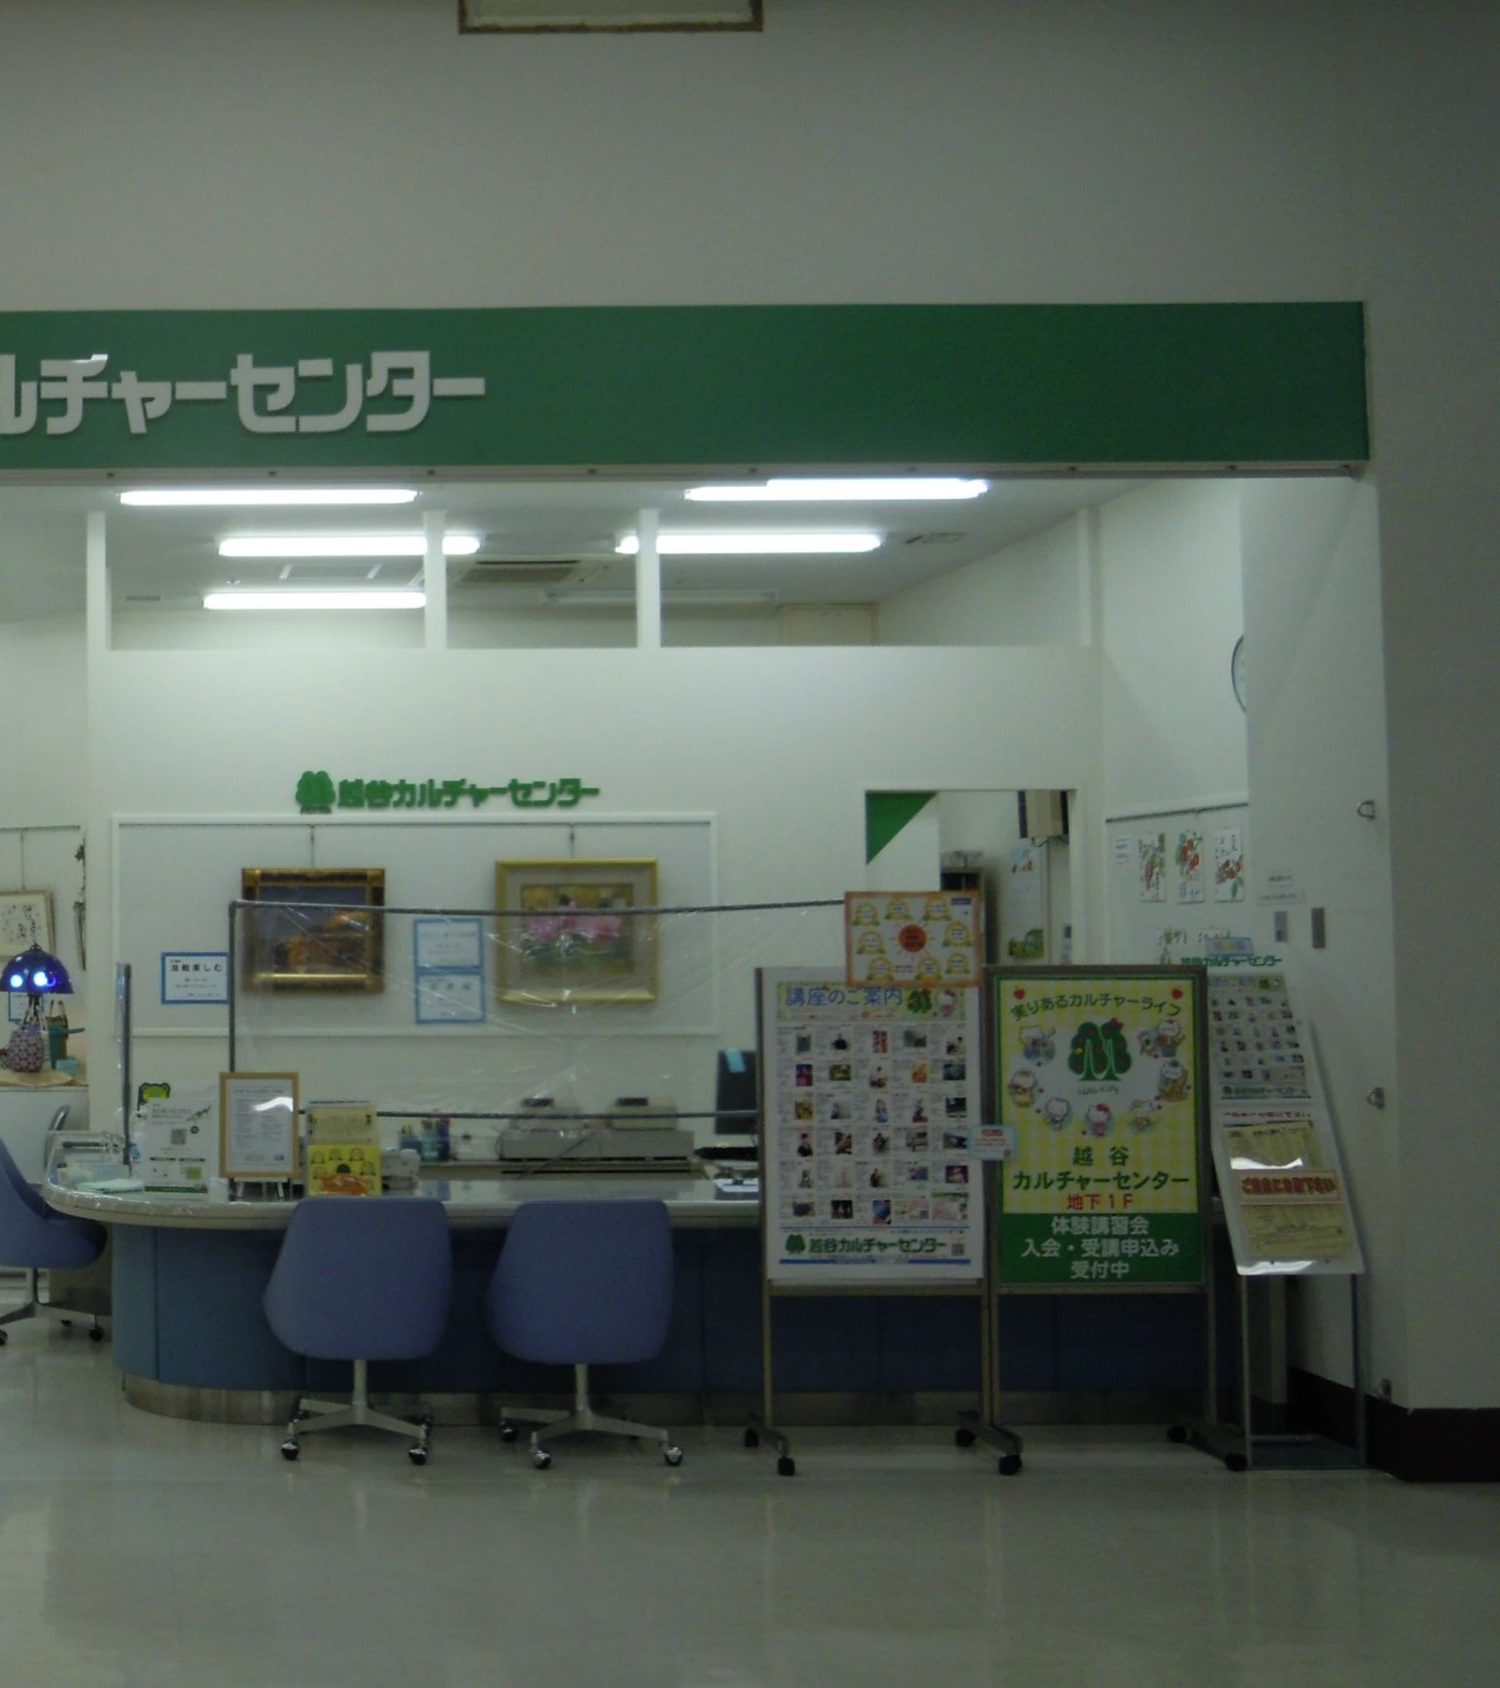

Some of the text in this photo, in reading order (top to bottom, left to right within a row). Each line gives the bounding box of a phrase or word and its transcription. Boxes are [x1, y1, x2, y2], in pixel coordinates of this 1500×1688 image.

[338, 778, 600, 808] 越谷カルチャーセンター
[786, 985, 903, 1007] 講座のご案内
[1010, 992, 1182, 1021] 実りあるカルチャーライフ
[1072, 1145, 1129, 1166] 越谷
[1013, 1171, 1190, 1190] カルチャーセンター
[1051, 1216, 1149, 1235] 体験講習会
[809, 1237, 947, 1253] 越谷カルチャーセンター
[1021, 1238, 1180, 1257] 入会・受講申込み
[1070, 1260, 1130, 1279] 受付中
